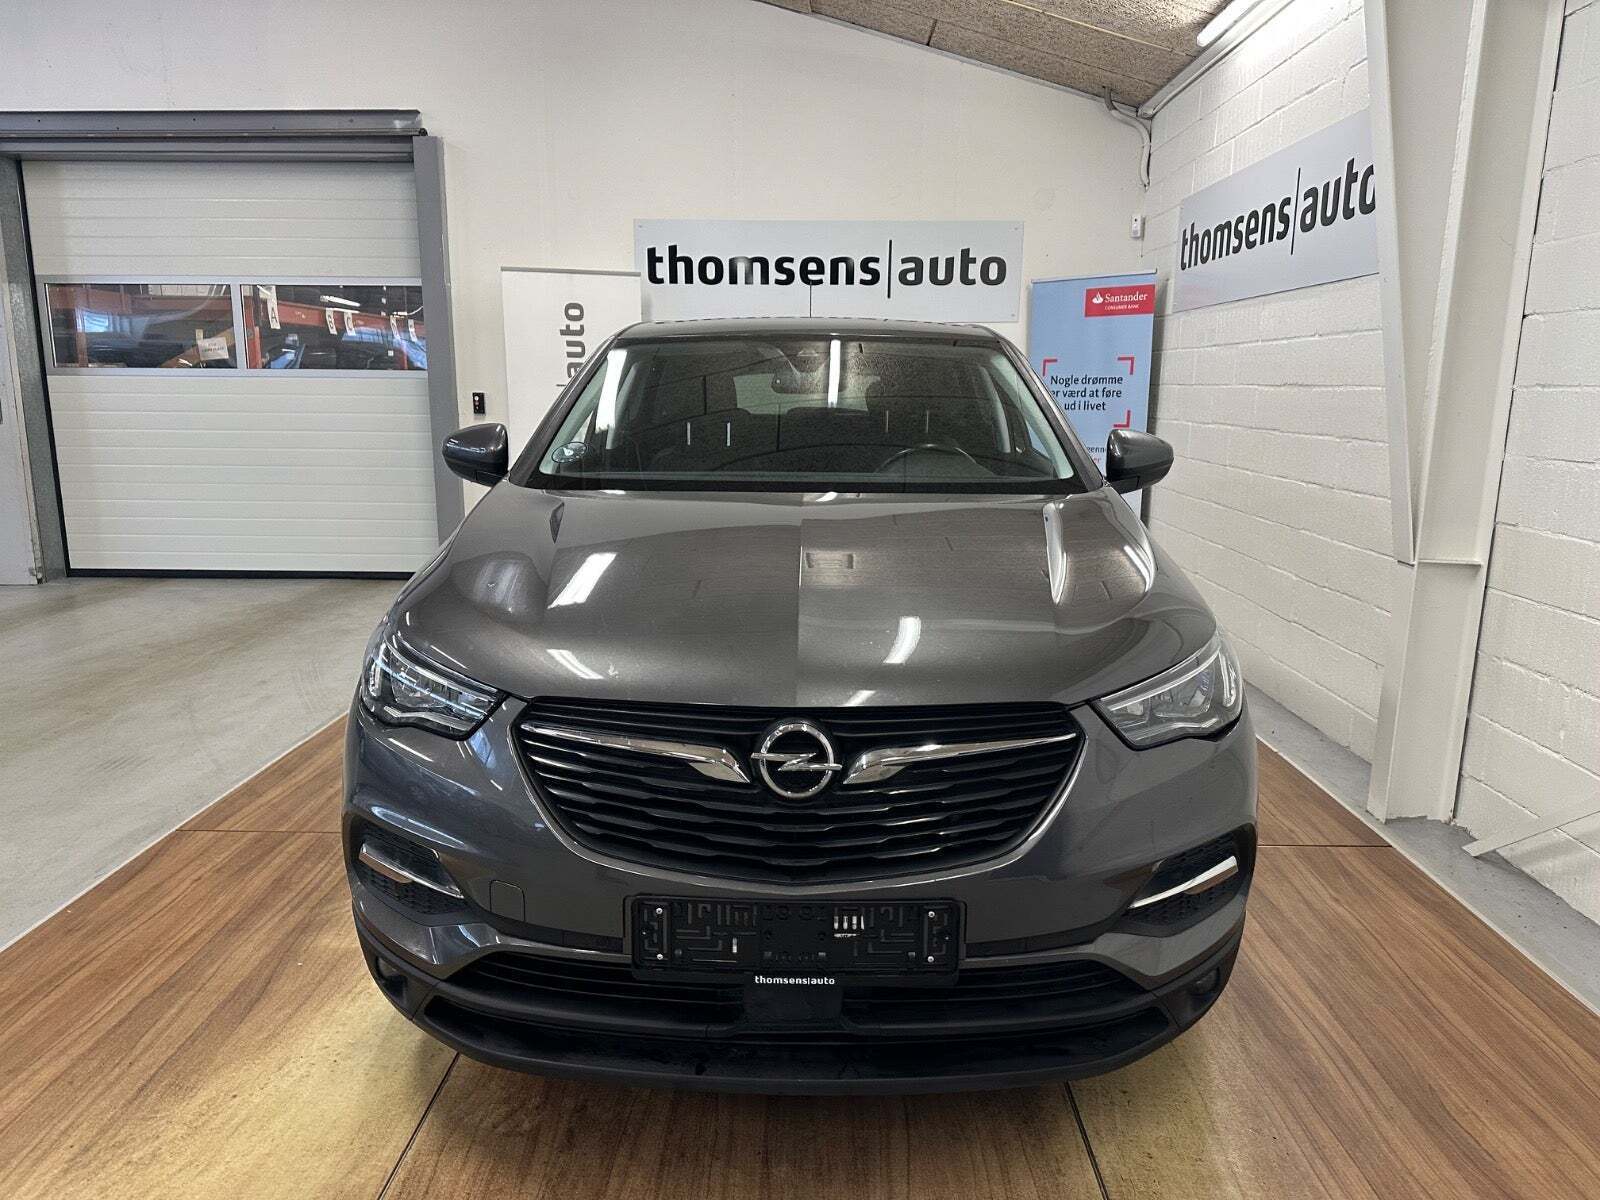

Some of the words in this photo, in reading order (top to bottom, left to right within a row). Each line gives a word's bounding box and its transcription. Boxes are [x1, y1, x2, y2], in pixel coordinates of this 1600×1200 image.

[1104, 291, 1148, 302] Santander
[1050, 374, 1079, 387] Nogle
[1081, 374, 1123, 385] drømme
[1062, 388, 1087, 398] værd
[1089, 389, 1100, 398] at
[1102, 387, 1122, 398] føre
[1064, 401, 1076, 411] ud
[1078, 401, 1081, 411] i
[1084, 401, 1106, 411] livet
